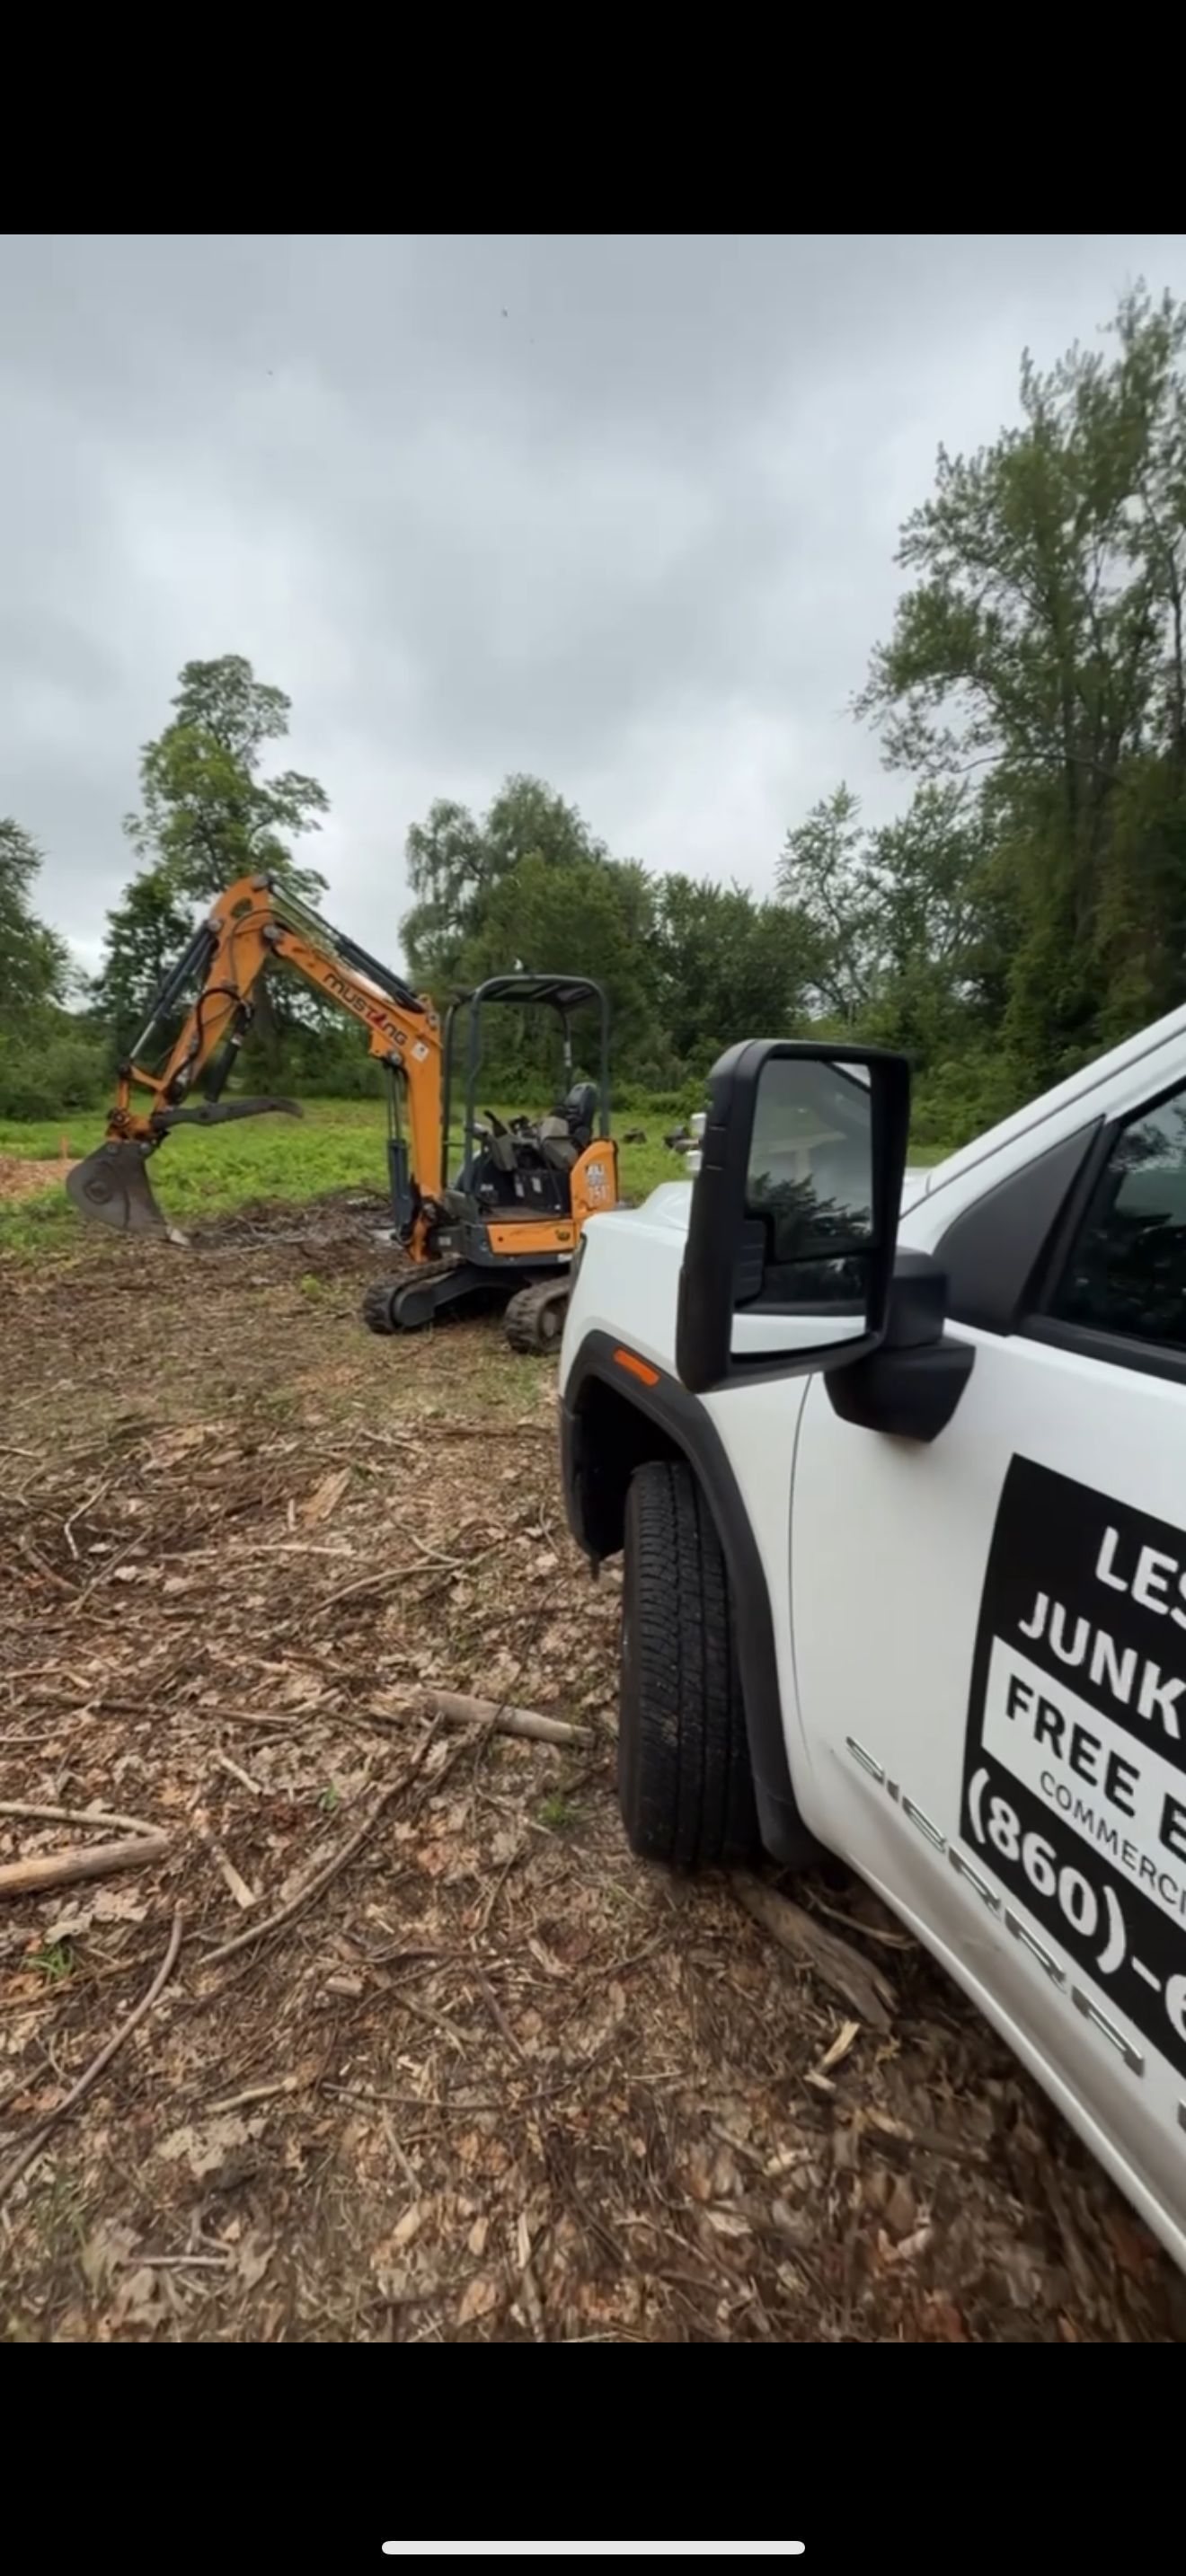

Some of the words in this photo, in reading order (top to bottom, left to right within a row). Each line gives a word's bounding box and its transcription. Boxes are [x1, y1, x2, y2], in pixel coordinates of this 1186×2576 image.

[323, 973, 407, 1045] MUSTANG
[1018, 1591, 1186, 1740] JUNK
[1005, 1673, 1141, 1819] FREE
